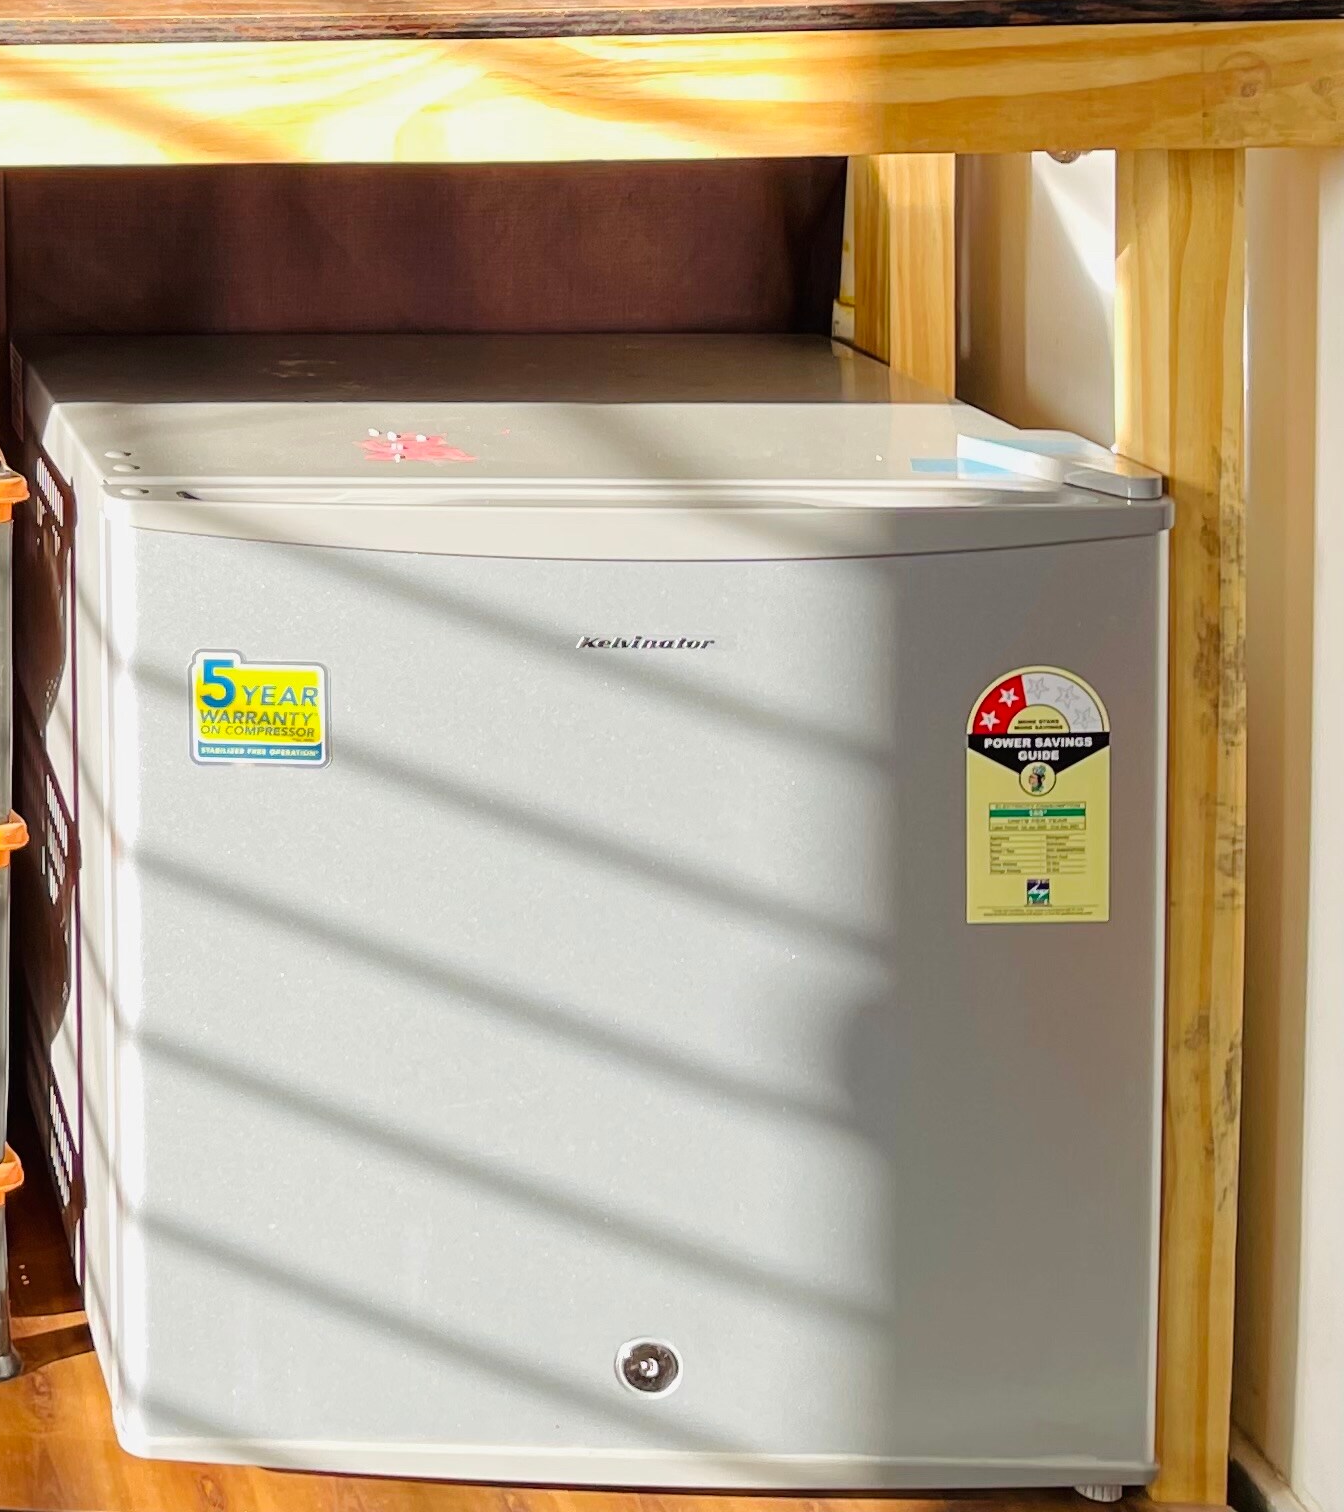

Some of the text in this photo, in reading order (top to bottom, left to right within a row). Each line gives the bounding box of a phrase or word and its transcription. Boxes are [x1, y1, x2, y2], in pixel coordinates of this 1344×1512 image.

[576, 635, 715, 650] Kelvinator
[200, 658, 319, 709] 5 YEAR
[200, 709, 313, 727] WARRANTY
[200, 725, 315, 738] ON COMPRESSOR
[984, 736, 1093, 749] POWER SAVINGS
[1017, 750, 1060, 762] GUIDE
